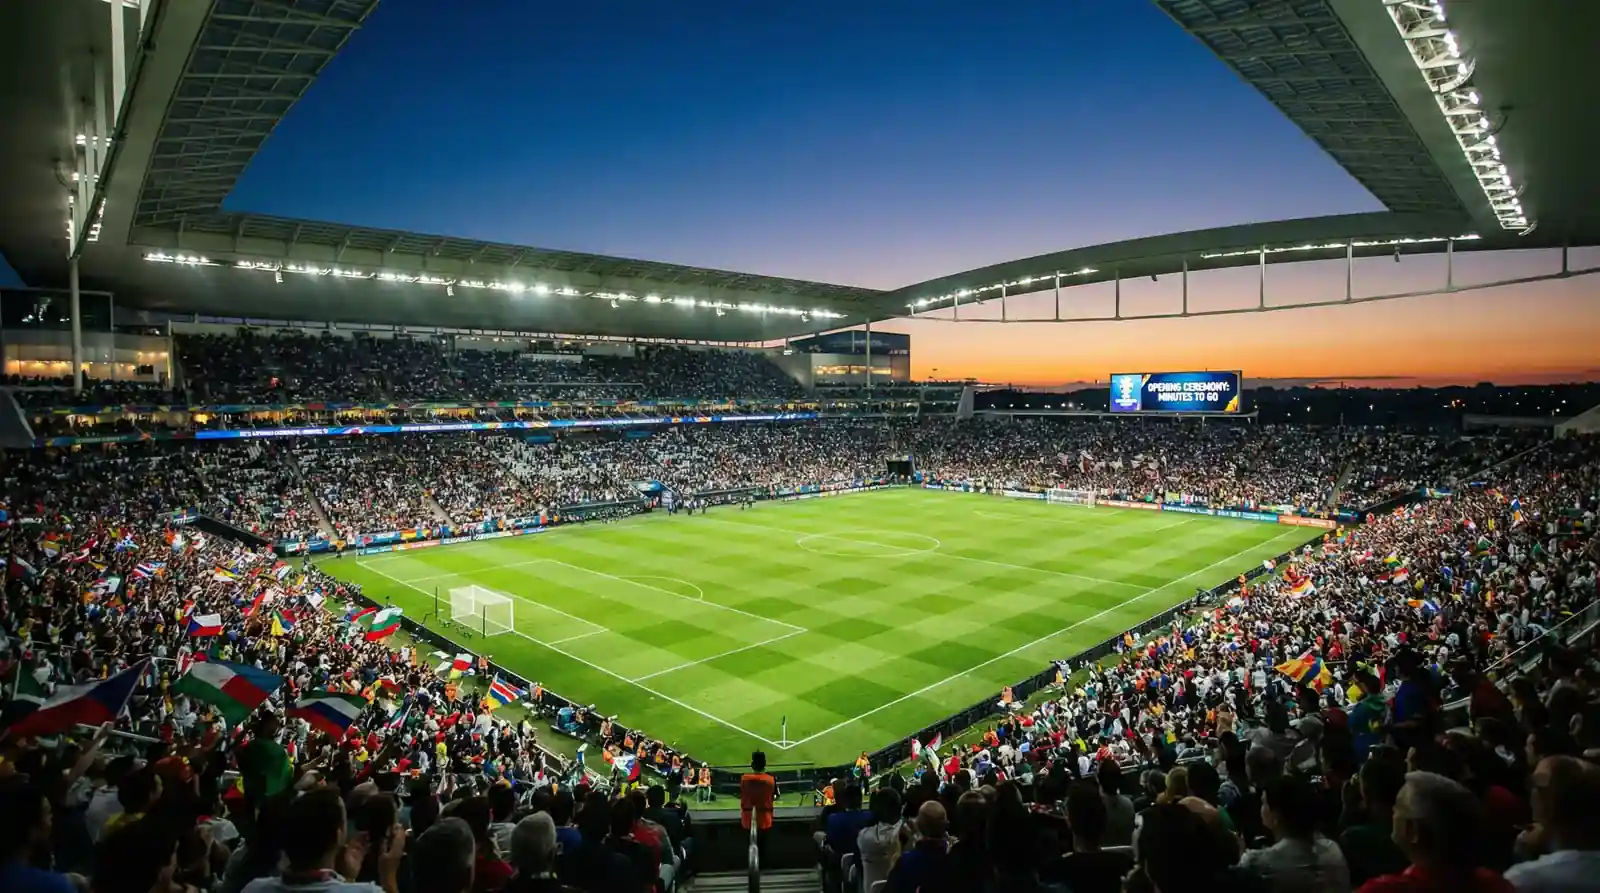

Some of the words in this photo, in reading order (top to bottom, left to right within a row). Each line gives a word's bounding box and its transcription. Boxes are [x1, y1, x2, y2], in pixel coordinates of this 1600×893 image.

[1147, 382, 1181, 392] OPENING
[1183, 381, 1231, 392] CEREMONY:
[1158, 392, 1193, 402] MINUTES
[1194, 392, 1205, 402] TO
[1206, 392, 1219, 402] GO
